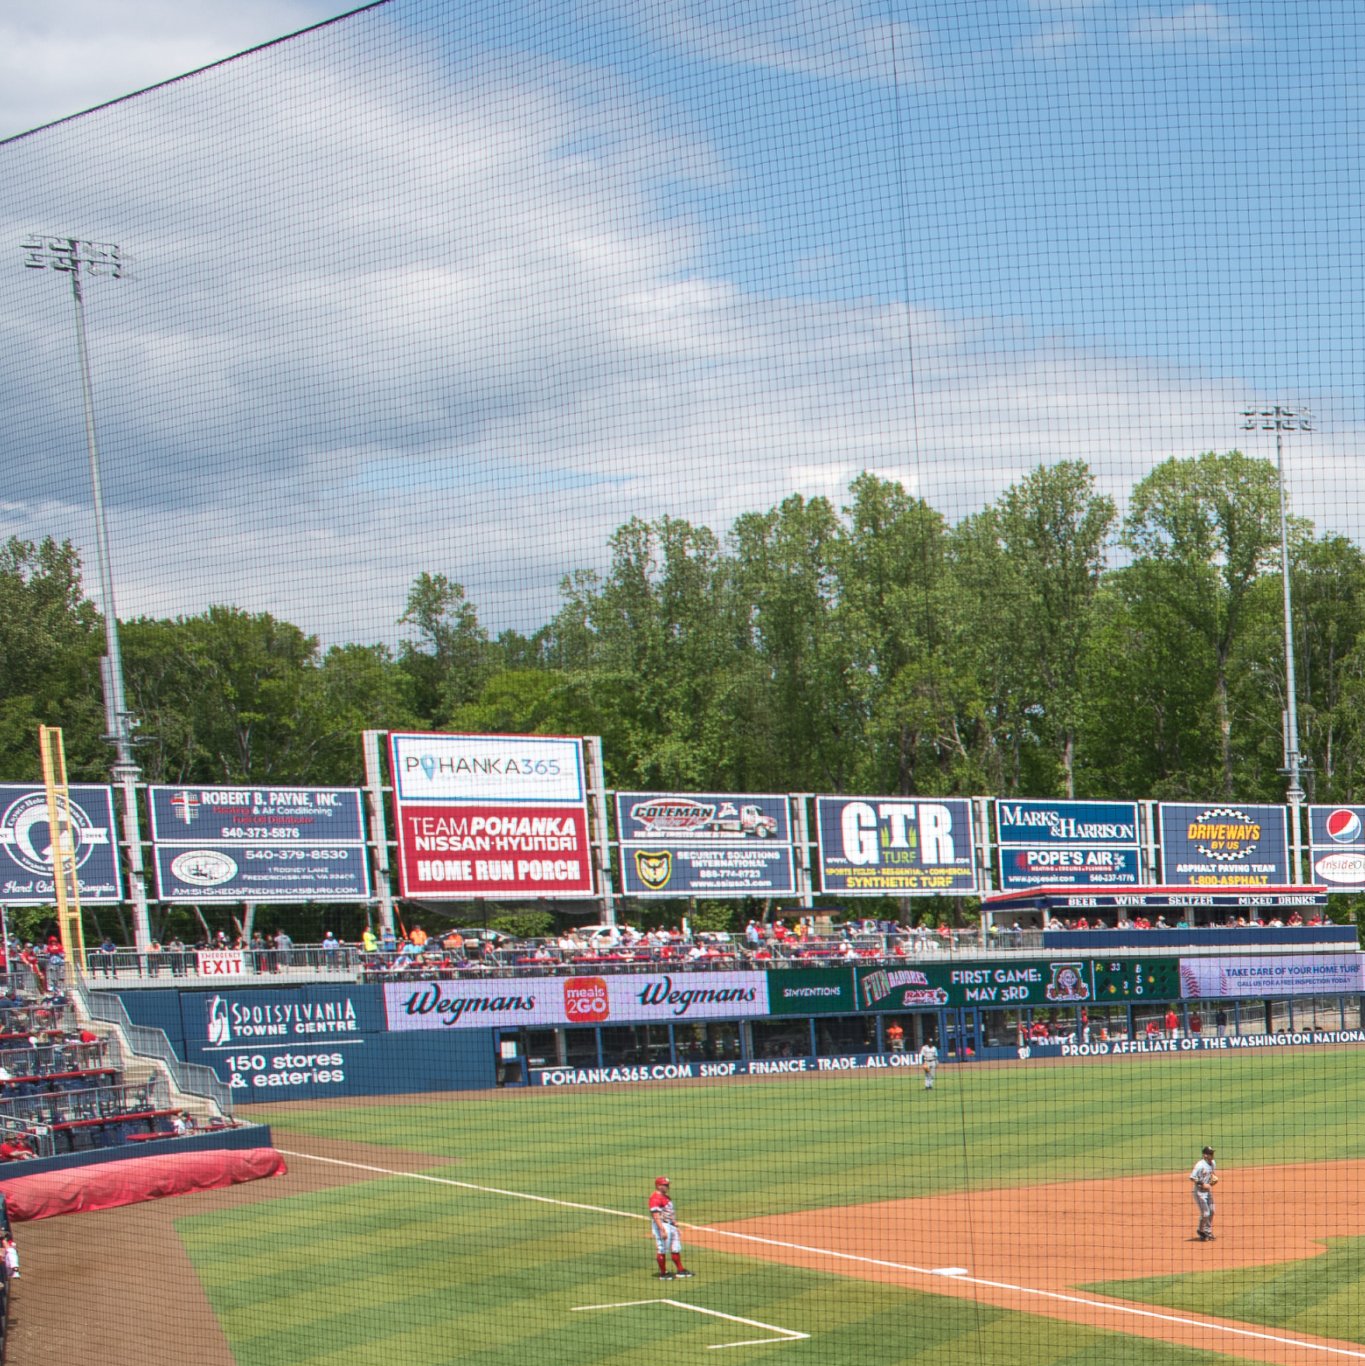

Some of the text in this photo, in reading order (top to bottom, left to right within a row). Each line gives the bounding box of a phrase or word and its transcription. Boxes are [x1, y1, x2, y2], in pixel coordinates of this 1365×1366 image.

[202, 791, 342, 808] ROBERT B. PAYNE, INC.
[634, 806, 713, 818] COLEMAN
[409, 816, 576, 836] TEAM POHANKA
[842, 801, 955, 865] GTR
[1188, 824, 1261, 840] DRIVEWAYS
[1211, 841, 1240, 850] BY US
[882, 852, 917, 863] TURF
[1027, 852, 1113, 865] POPE'S AIR
[417, 860, 581, 881] HOME RUN PORCH
[1176, 864, 1276, 873] ASPHALT PAVING TEAM
[847, 877, 953, 888] SYNTHETIC TURF
[1068, 897, 1097, 906] BEER
[1114, 896, 1146, 905] WINE
[1278, 896, 1316, 904] DRINKS
[203, 959, 242, 975] EXIT
[1226, 968, 1249, 977] TAKE
[1250, 967, 1274, 976] CARE
[1275, 967, 1286, 976] OF
[1287, 966, 1312, 975] YOUR
[1313, 966, 1337, 974] HOME
[951, 969, 1042, 985] FIRST GAME:
[566, 987, 606, 1001] meals
[636, 976, 757, 1016] Wegmans
[966, 986, 1029, 1001] MAY 3RD
[232, 998, 357, 1025] SPOTSYLVANIA
[403, 983, 536, 1025] Wegmans
[567, 999, 607, 1015] 2GO
[233, 1021, 359, 1036] TOWNE CENTRE
[1062, 1042, 1108, 1056] PROUD
[1112, 1040, 1178, 1054] AFFILIATE
[1182, 1038, 1199, 1050] OF
[1202, 1037, 1226, 1049] THE
[1230, 1033, 1310, 1049] WASHINGTON
[225, 1053, 343, 1072] 150 stores
[231, 1069, 344, 1088] & eateries
[542, 1059, 806, 1086] POHANKA365.COM SHOP FINANCE
